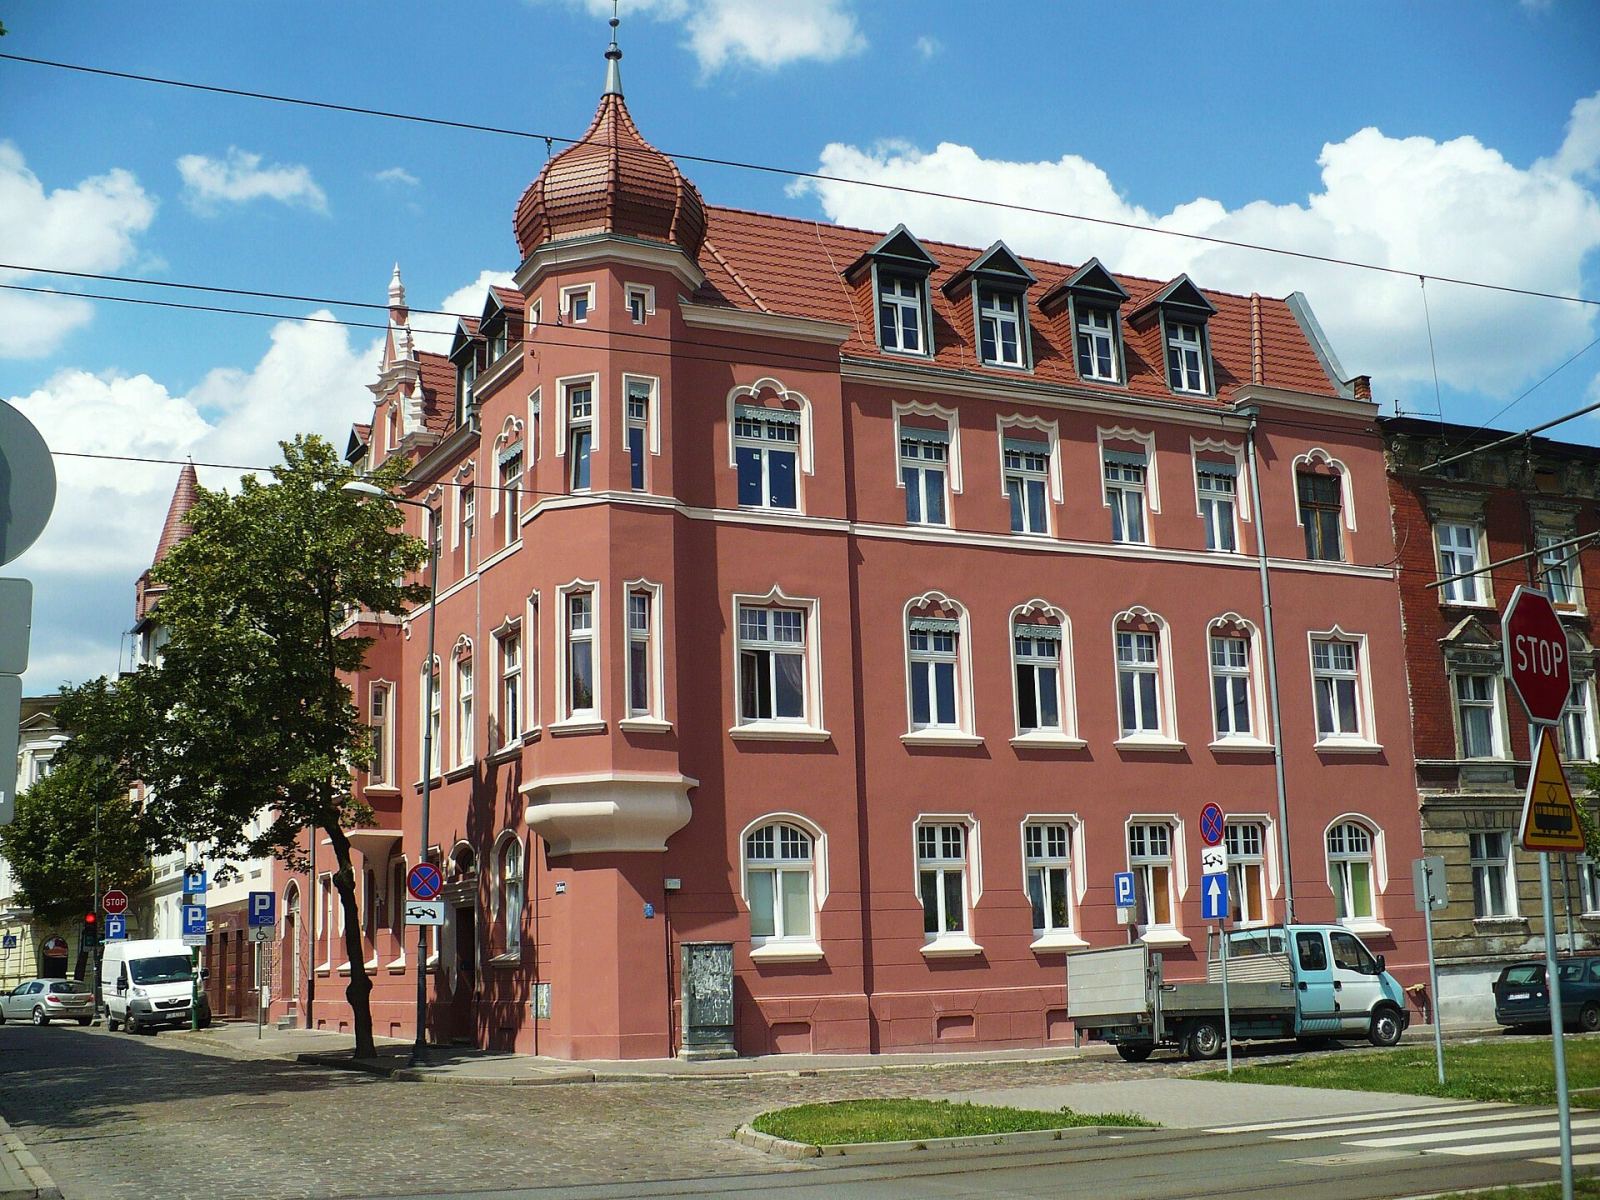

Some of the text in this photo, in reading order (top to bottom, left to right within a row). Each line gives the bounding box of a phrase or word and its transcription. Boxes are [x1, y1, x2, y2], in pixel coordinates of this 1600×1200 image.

[1515, 634, 1563, 678] STOP
[188, 872, 202, 891] P
[1118, 876, 1130, 903] P
[105, 898, 126, 907] STOP
[254, 894, 270, 916] P
[187, 907, 202, 926] P
[109, 921, 121, 937] P
